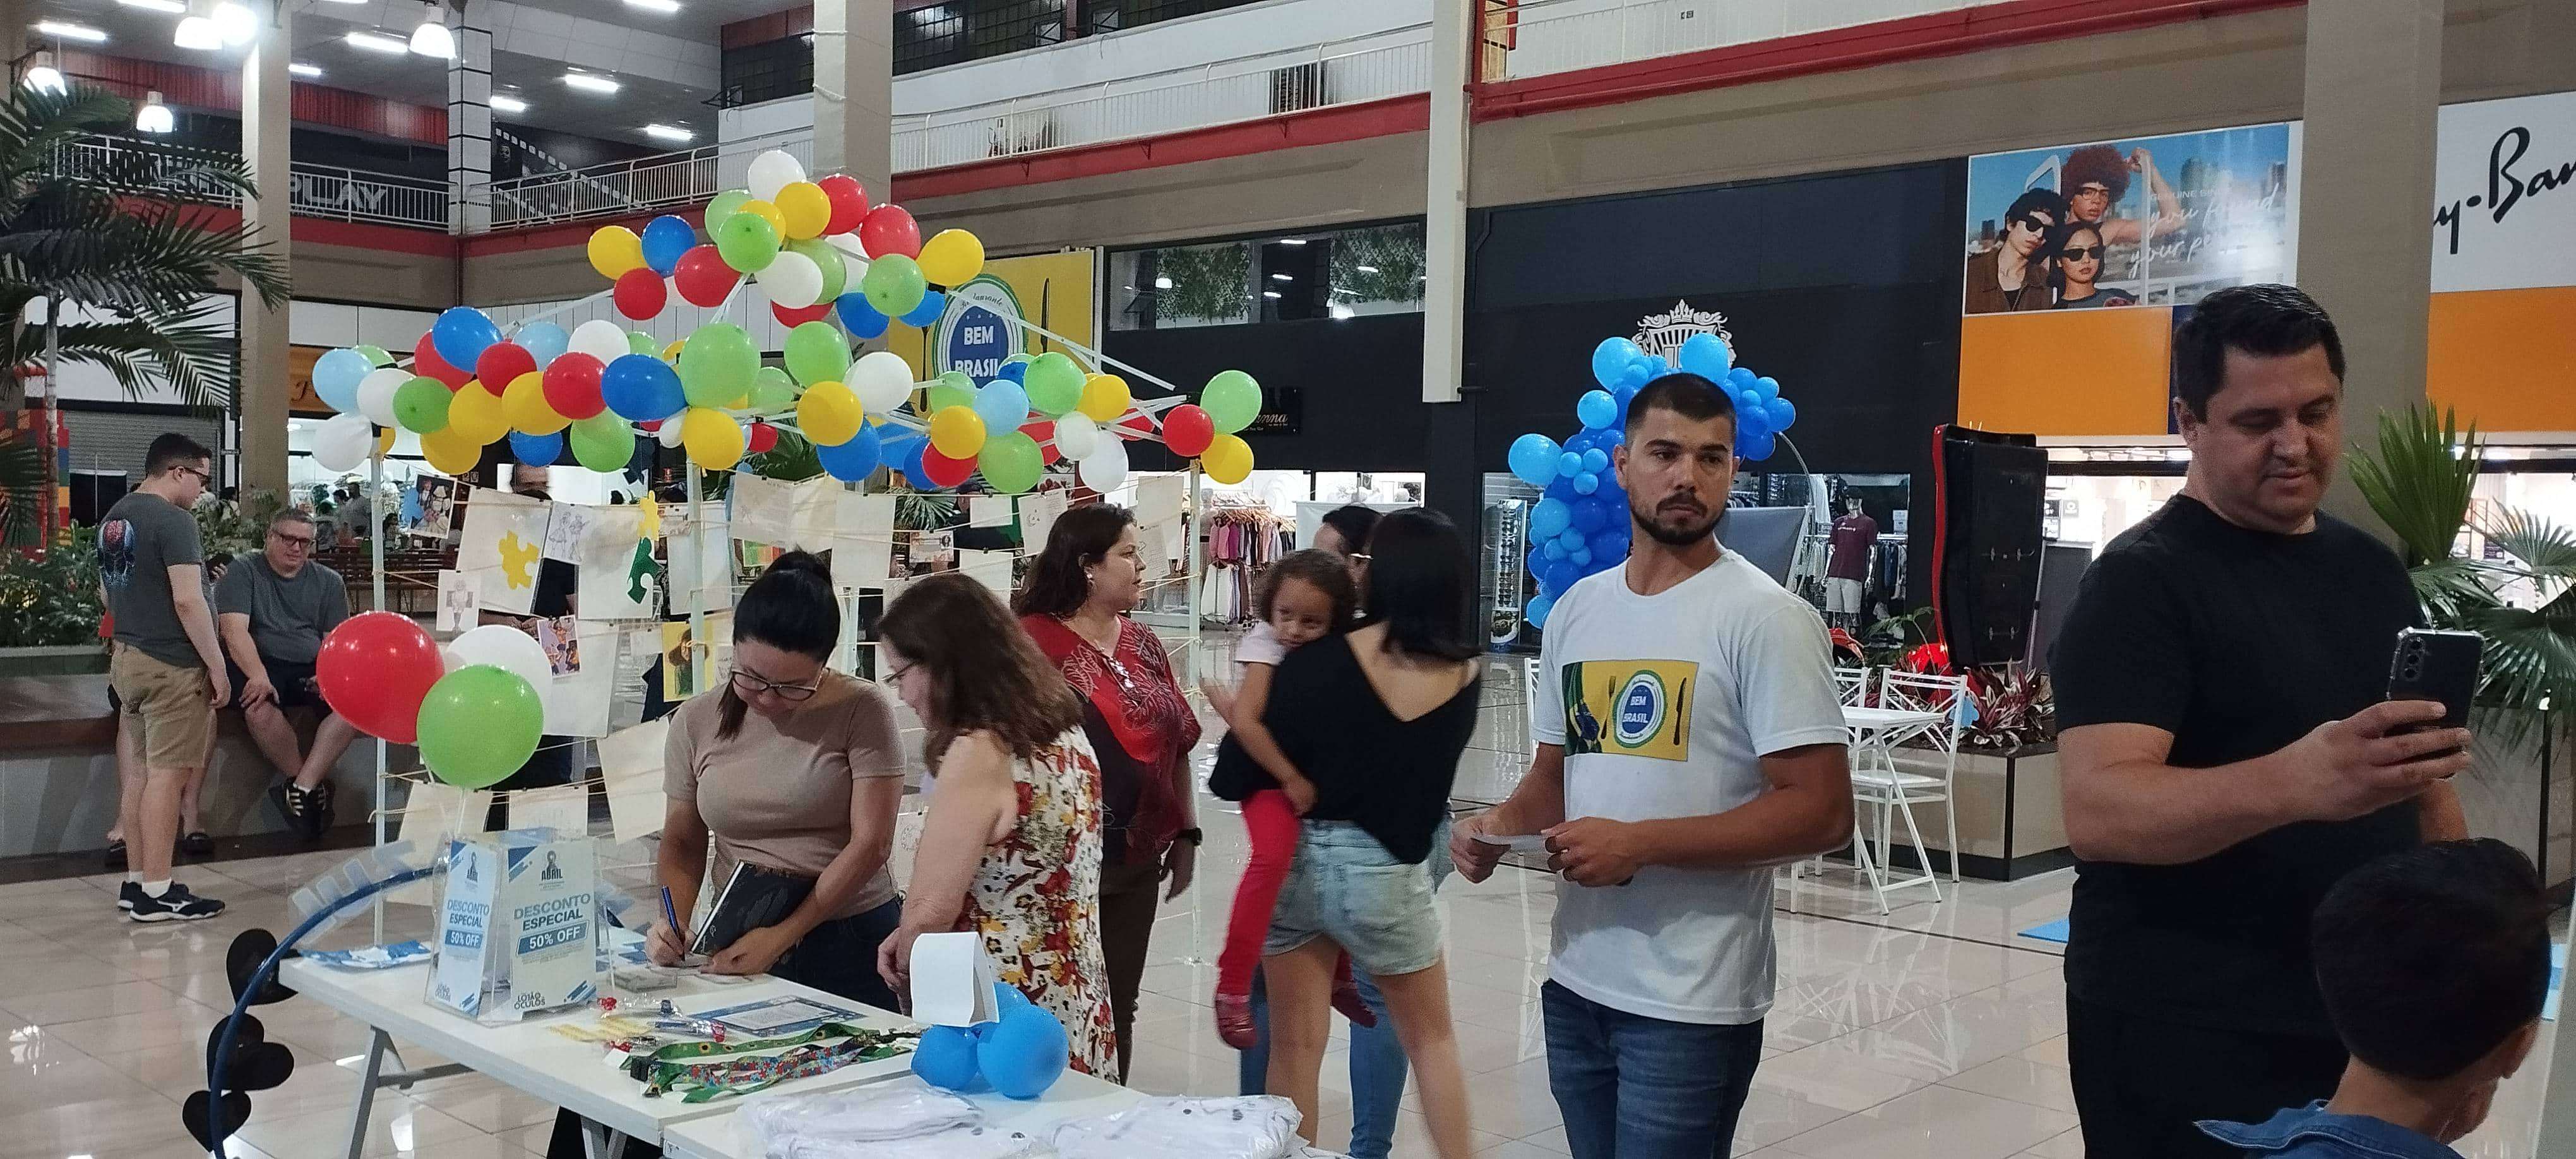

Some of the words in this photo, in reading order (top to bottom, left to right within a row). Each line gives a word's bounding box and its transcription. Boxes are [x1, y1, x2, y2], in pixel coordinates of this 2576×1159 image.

[2147, 208, 2198, 239] you
[2128, 241, 2185, 279] your
[964, 326, 994, 345] BEM
[955, 358, 999, 377] BRASIL
[1630, 696, 1647, 706] BEM
[1623, 713, 1649, 723] BRASIL
[541, 868, 563, 881] ABRIL
[447, 899, 490, 915] DESCONTO
[514, 893, 591, 920] DESCONTO
[449, 913, 483, 927] ESPECIAL
[523, 908, 583, 932] ESPECIAL
[450, 931, 464, 945] 50%
[465, 934, 480, 947] OFF
[529, 933, 554, 949] 50%
[557, 926, 581, 942] OFF
